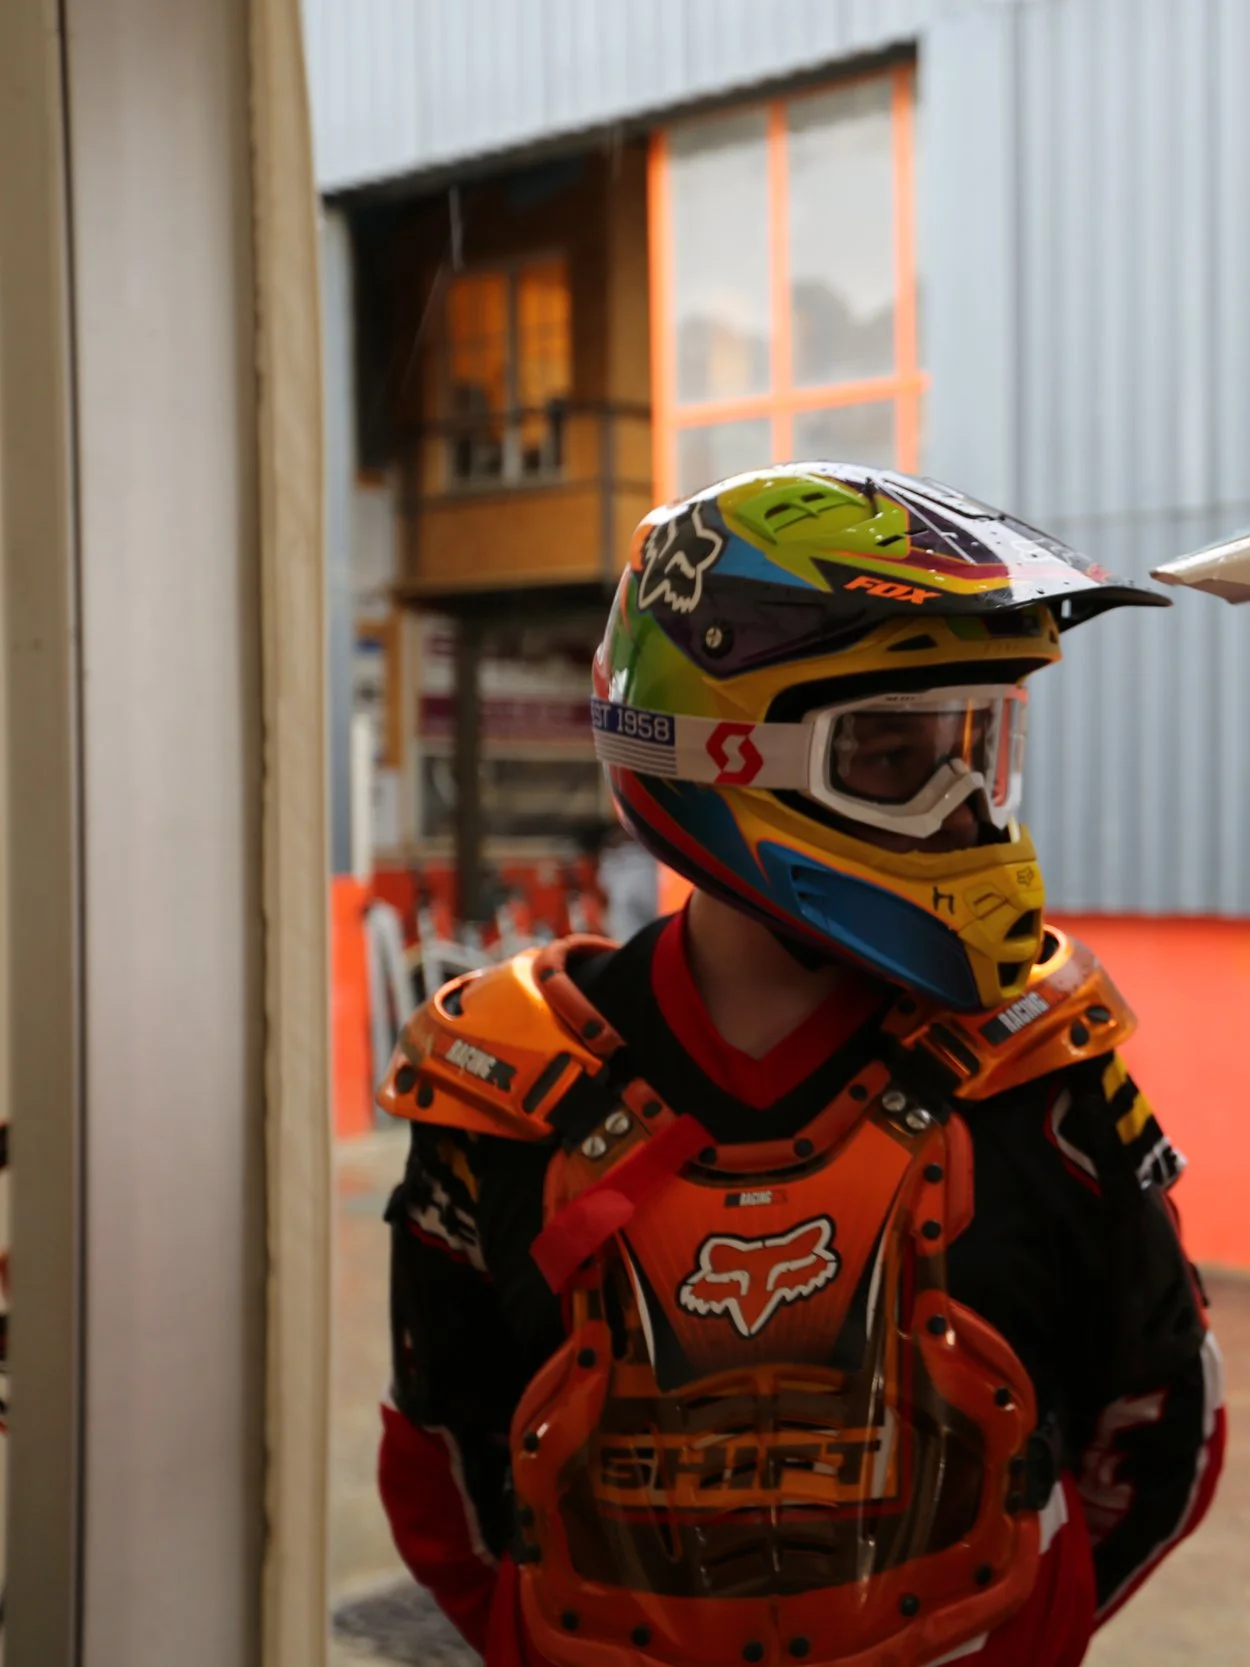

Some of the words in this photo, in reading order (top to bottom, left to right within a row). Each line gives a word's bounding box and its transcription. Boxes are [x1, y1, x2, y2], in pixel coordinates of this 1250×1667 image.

[843, 575, 942, 605] FOX
[617, 708, 671, 742] 1958
[998, 992, 1050, 1033] RACING
